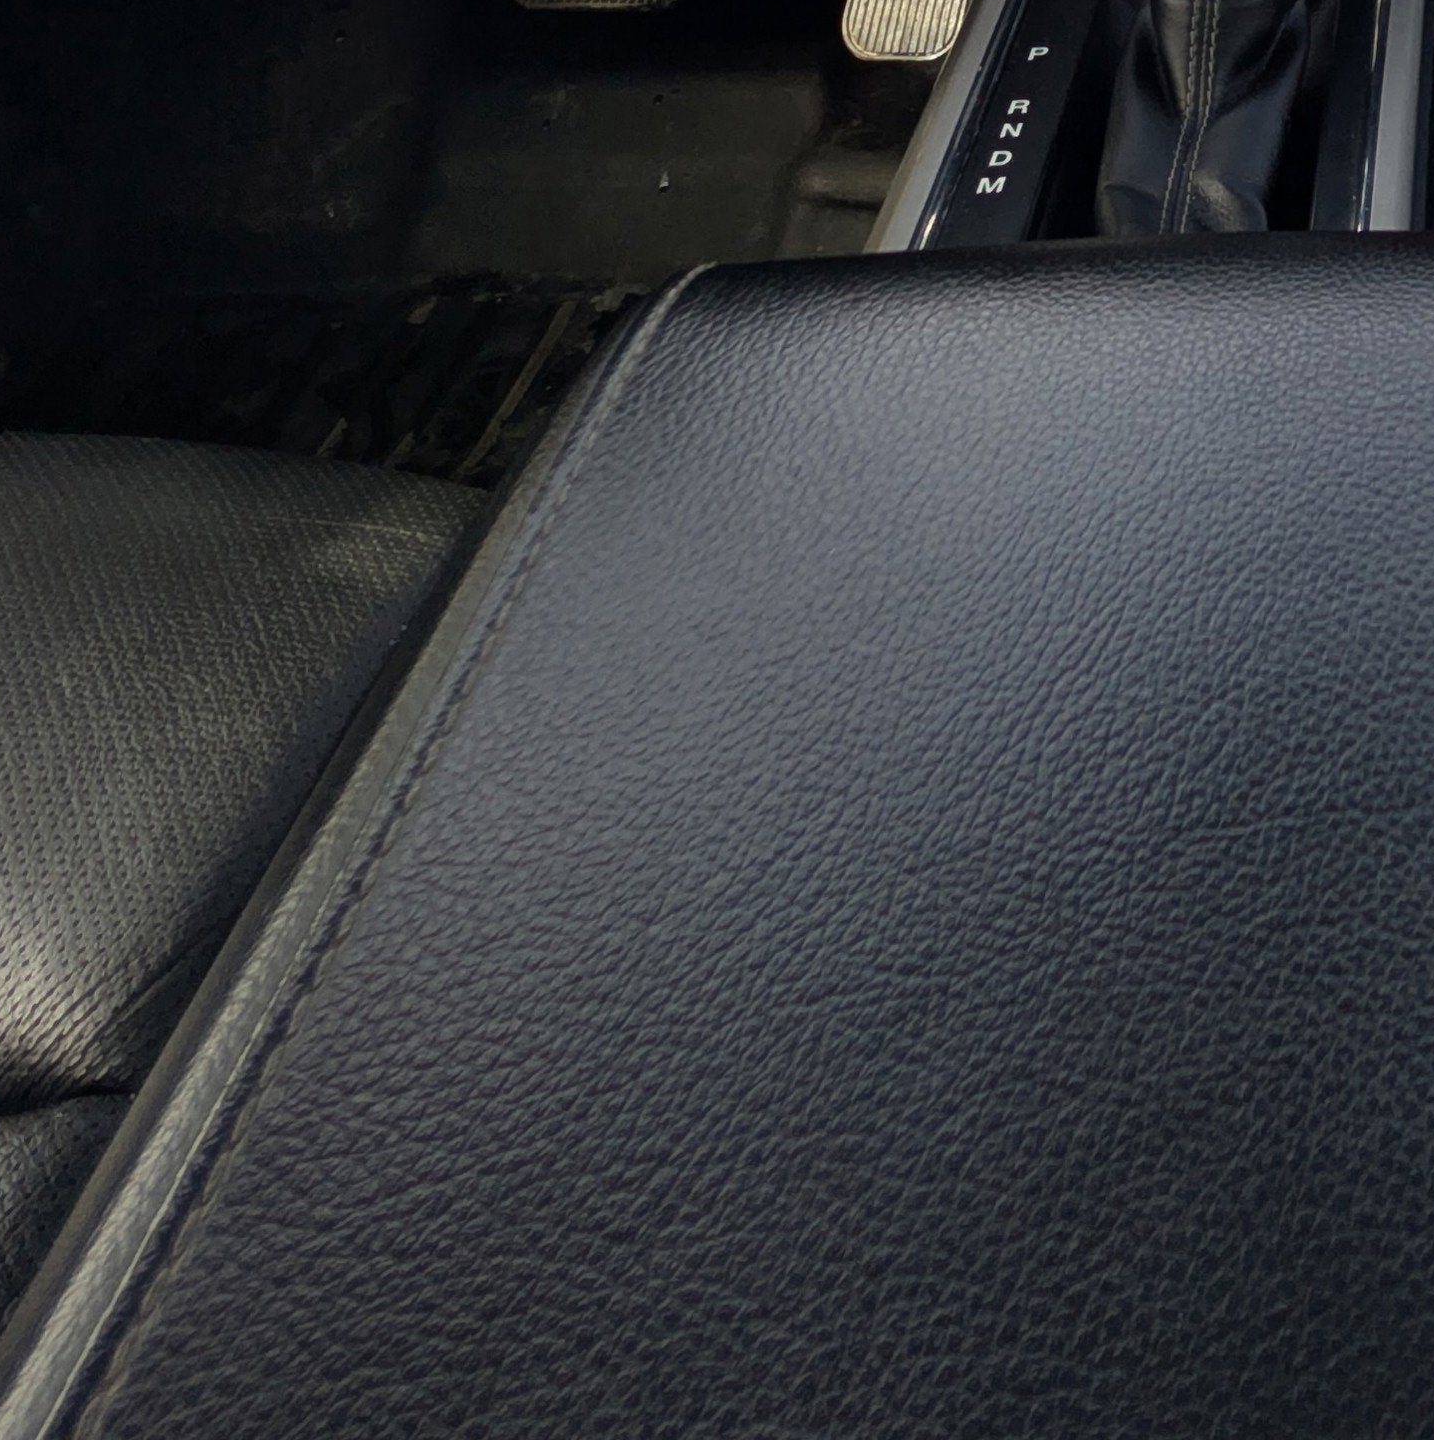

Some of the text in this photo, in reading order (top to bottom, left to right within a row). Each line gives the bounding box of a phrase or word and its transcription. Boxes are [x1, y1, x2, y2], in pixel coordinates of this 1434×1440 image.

[1027, 46, 1049, 61] P
[1007, 99, 1031, 115] R
[999, 122, 1024, 139] N
[988, 150, 1013, 167] D
[975, 176, 1007, 194] M
